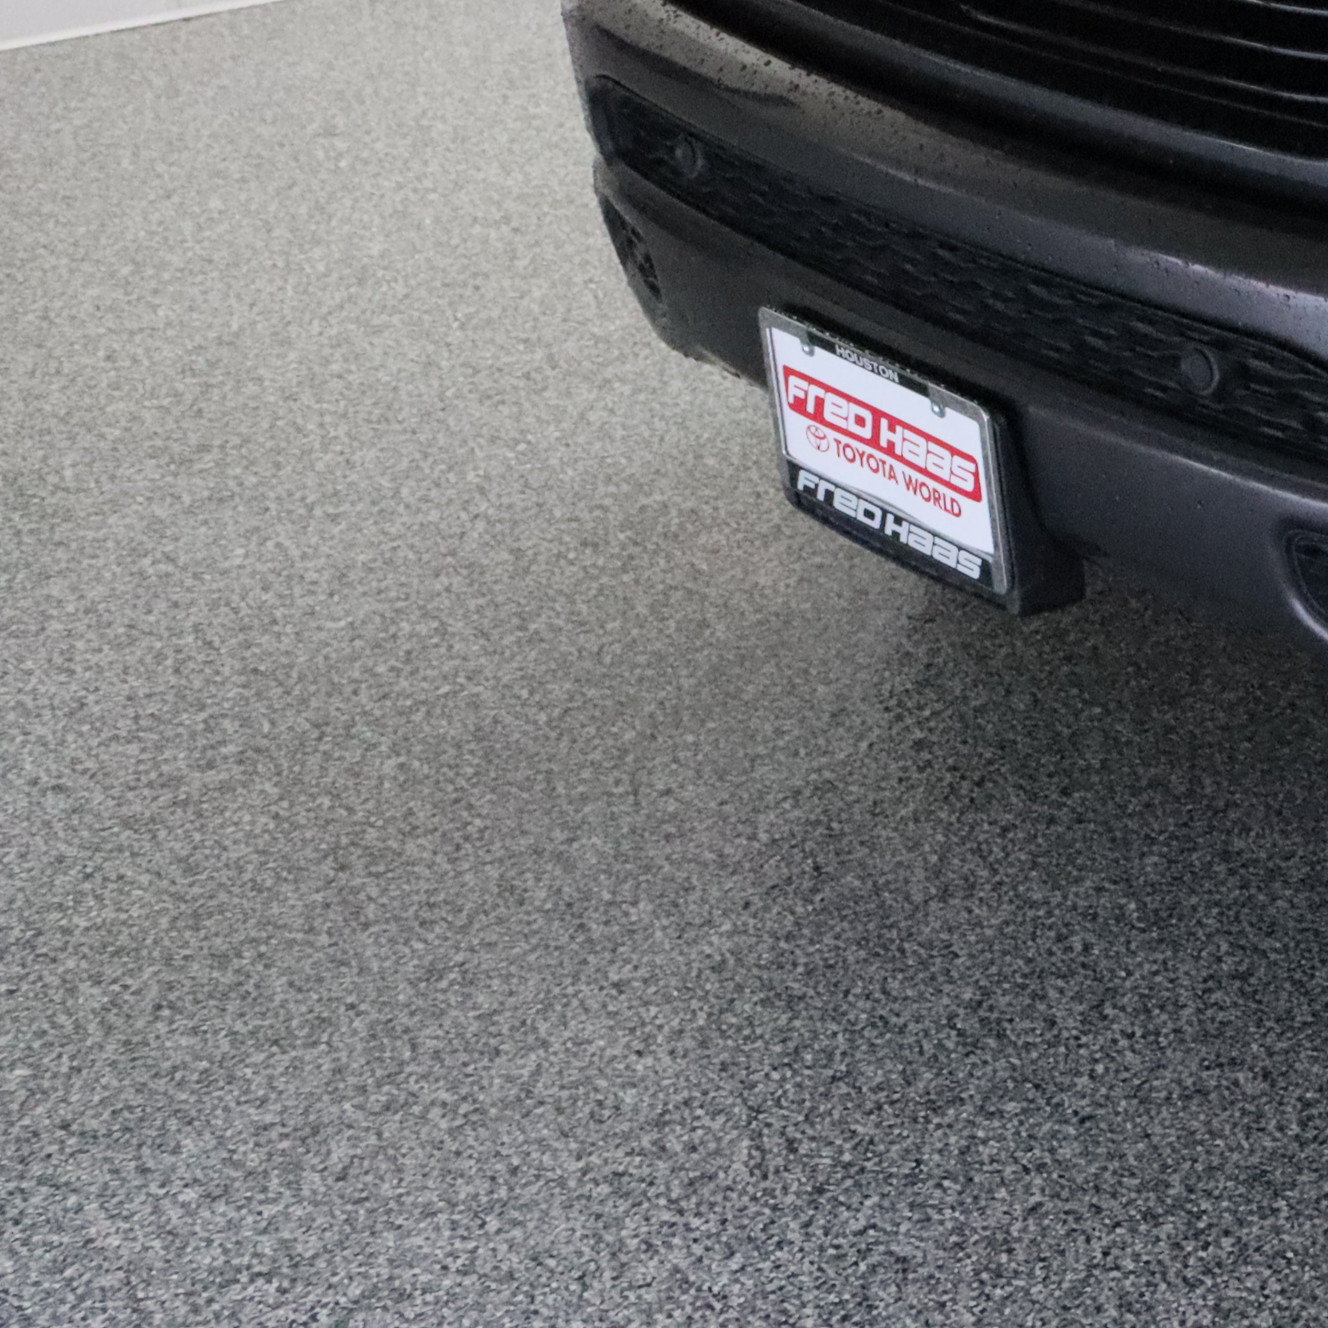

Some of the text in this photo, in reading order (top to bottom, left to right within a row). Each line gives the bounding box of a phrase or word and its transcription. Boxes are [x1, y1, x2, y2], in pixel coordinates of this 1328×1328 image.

[837, 344, 899, 383] HOUSTON
[834, 438, 961, 518] TOYOTA WORLD
